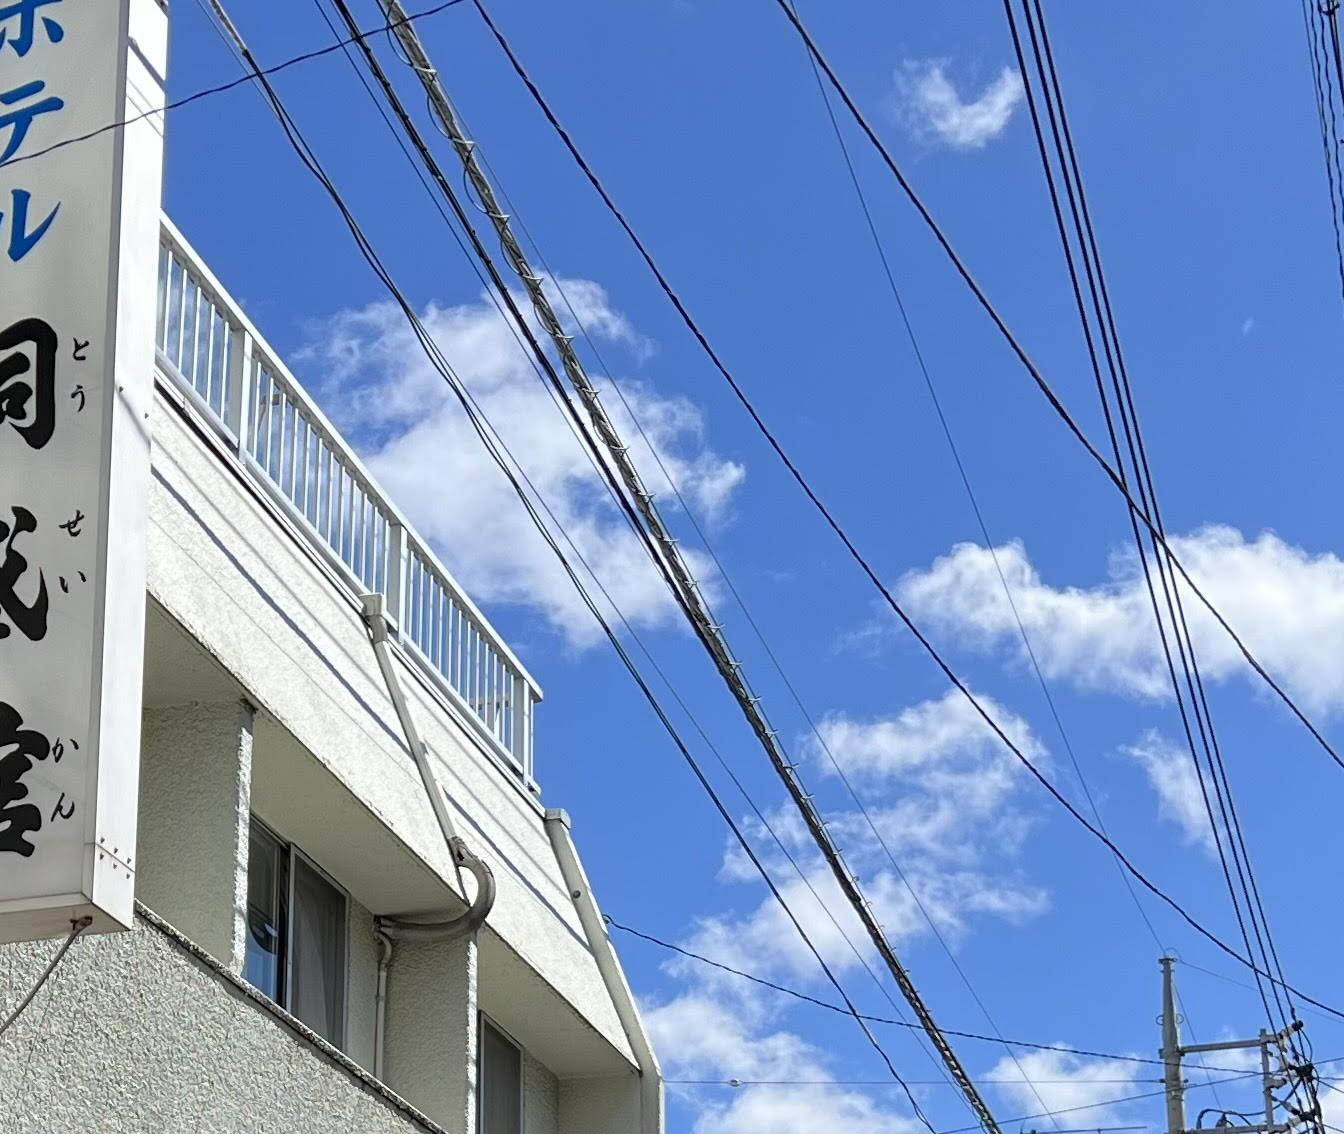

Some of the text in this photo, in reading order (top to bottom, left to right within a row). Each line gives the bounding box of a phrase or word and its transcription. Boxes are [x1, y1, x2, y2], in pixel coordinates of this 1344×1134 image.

[49, 336, 91, 820] とう せい かん
